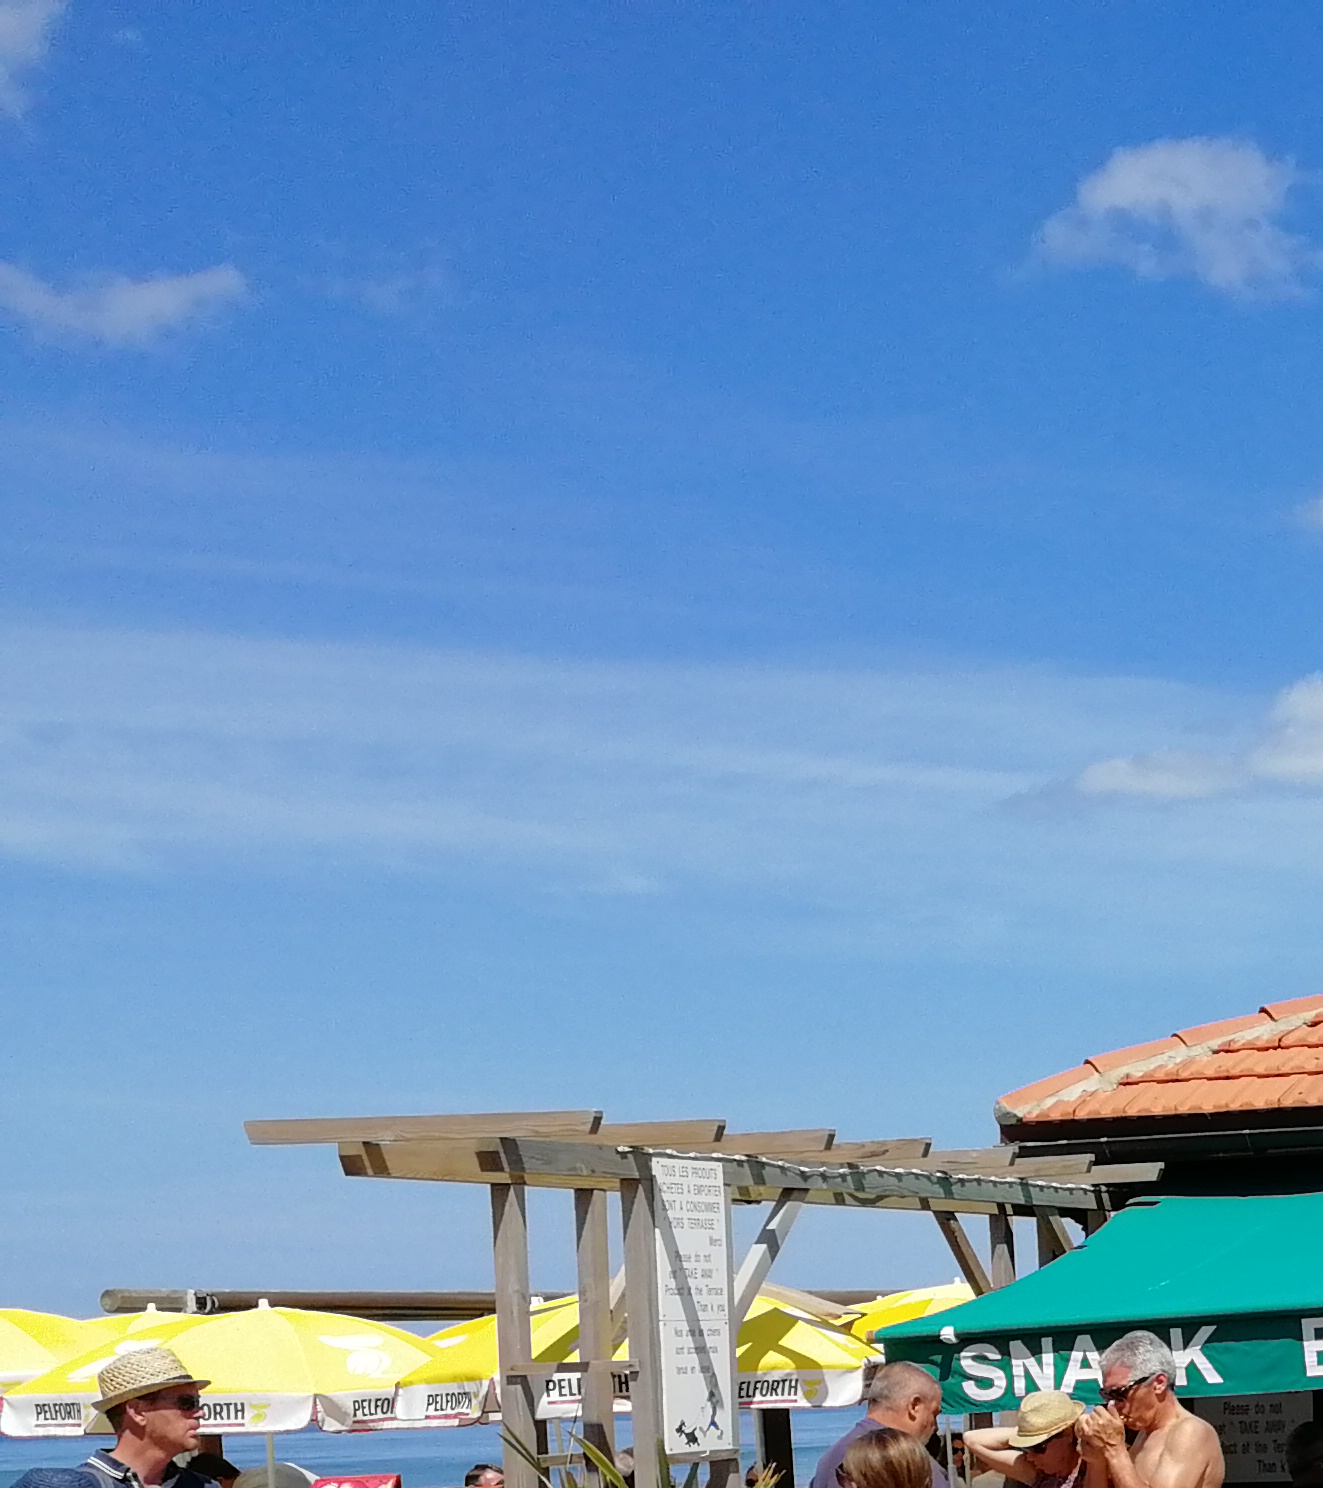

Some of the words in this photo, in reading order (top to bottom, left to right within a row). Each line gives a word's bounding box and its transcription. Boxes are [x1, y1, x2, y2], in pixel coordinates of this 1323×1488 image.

[960, 1325, 1224, 1401] SNAK
[737, 1378, 799, 1399] ELFORTH
[34, 1402, 82, 1421] PELFORTH
[199, 1402, 246, 1421] ORTH
[1223, 1402, 1250, 1416] Please
[1255, 1402, 1266, 1415] do
[1239, 1420, 1260, 1434] TAKE
[1272, 1439, 1286, 1453] Ter
